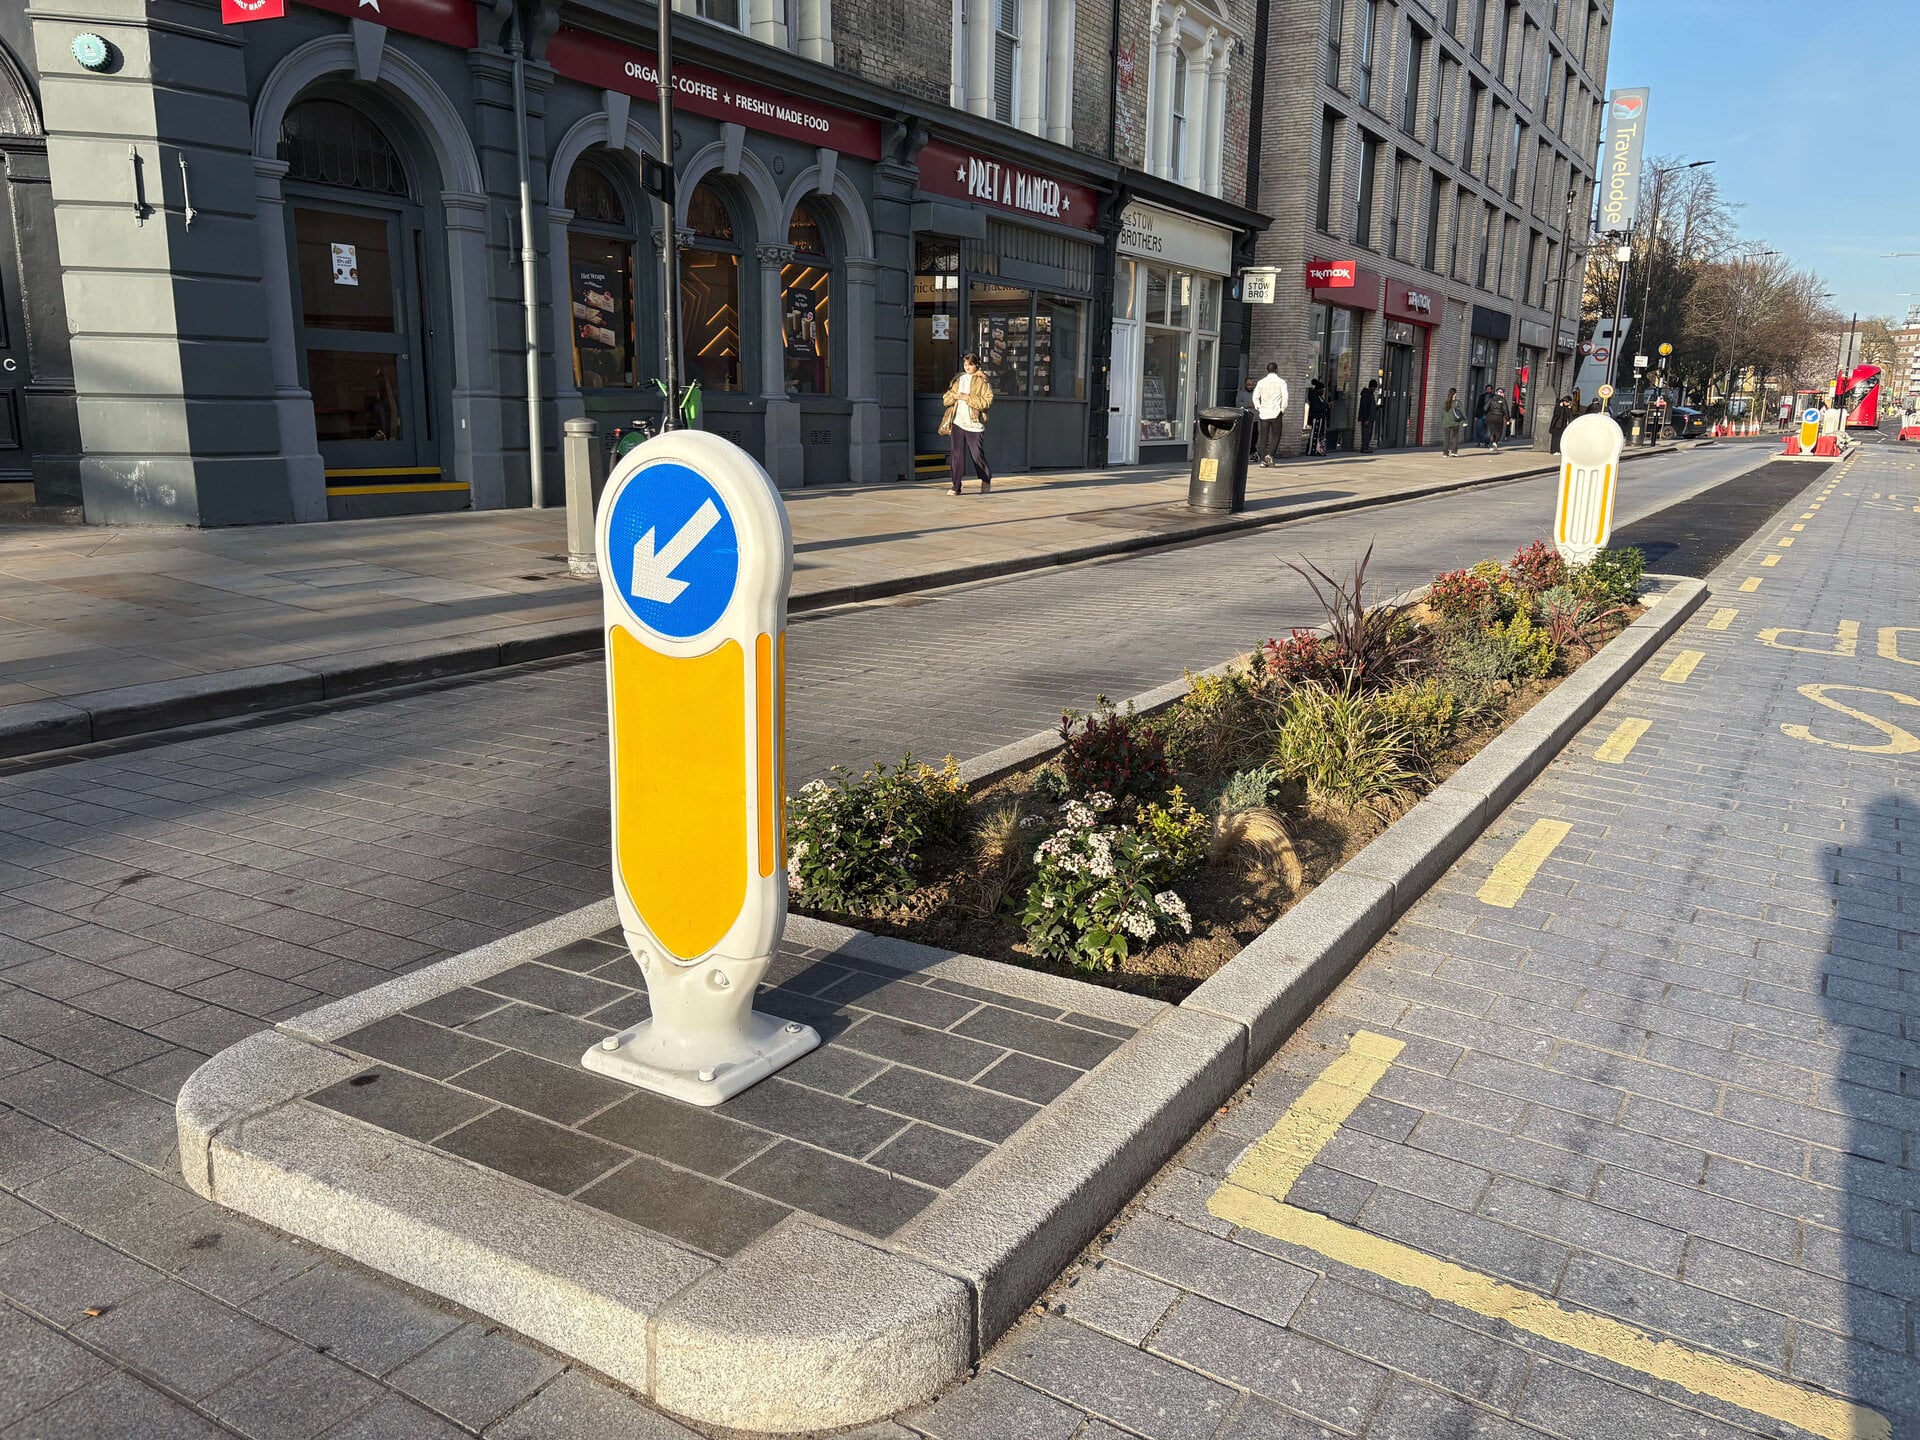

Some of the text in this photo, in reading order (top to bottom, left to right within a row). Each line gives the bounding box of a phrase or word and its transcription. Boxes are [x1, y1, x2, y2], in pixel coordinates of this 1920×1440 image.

[625, 61, 829, 132] ORGAC COFFEE FRESHLY MADE FOOD
[1603, 122, 1637, 224] Travelodge
[968, 156, 1060, 218] PRET A MANGER
[1122, 211, 1154, 232] THE STOW
[1121, 229, 1162, 253] BROTHERS
[1247, 282, 1271, 290] STOW
[1248, 290, 1270, 298] BROS
